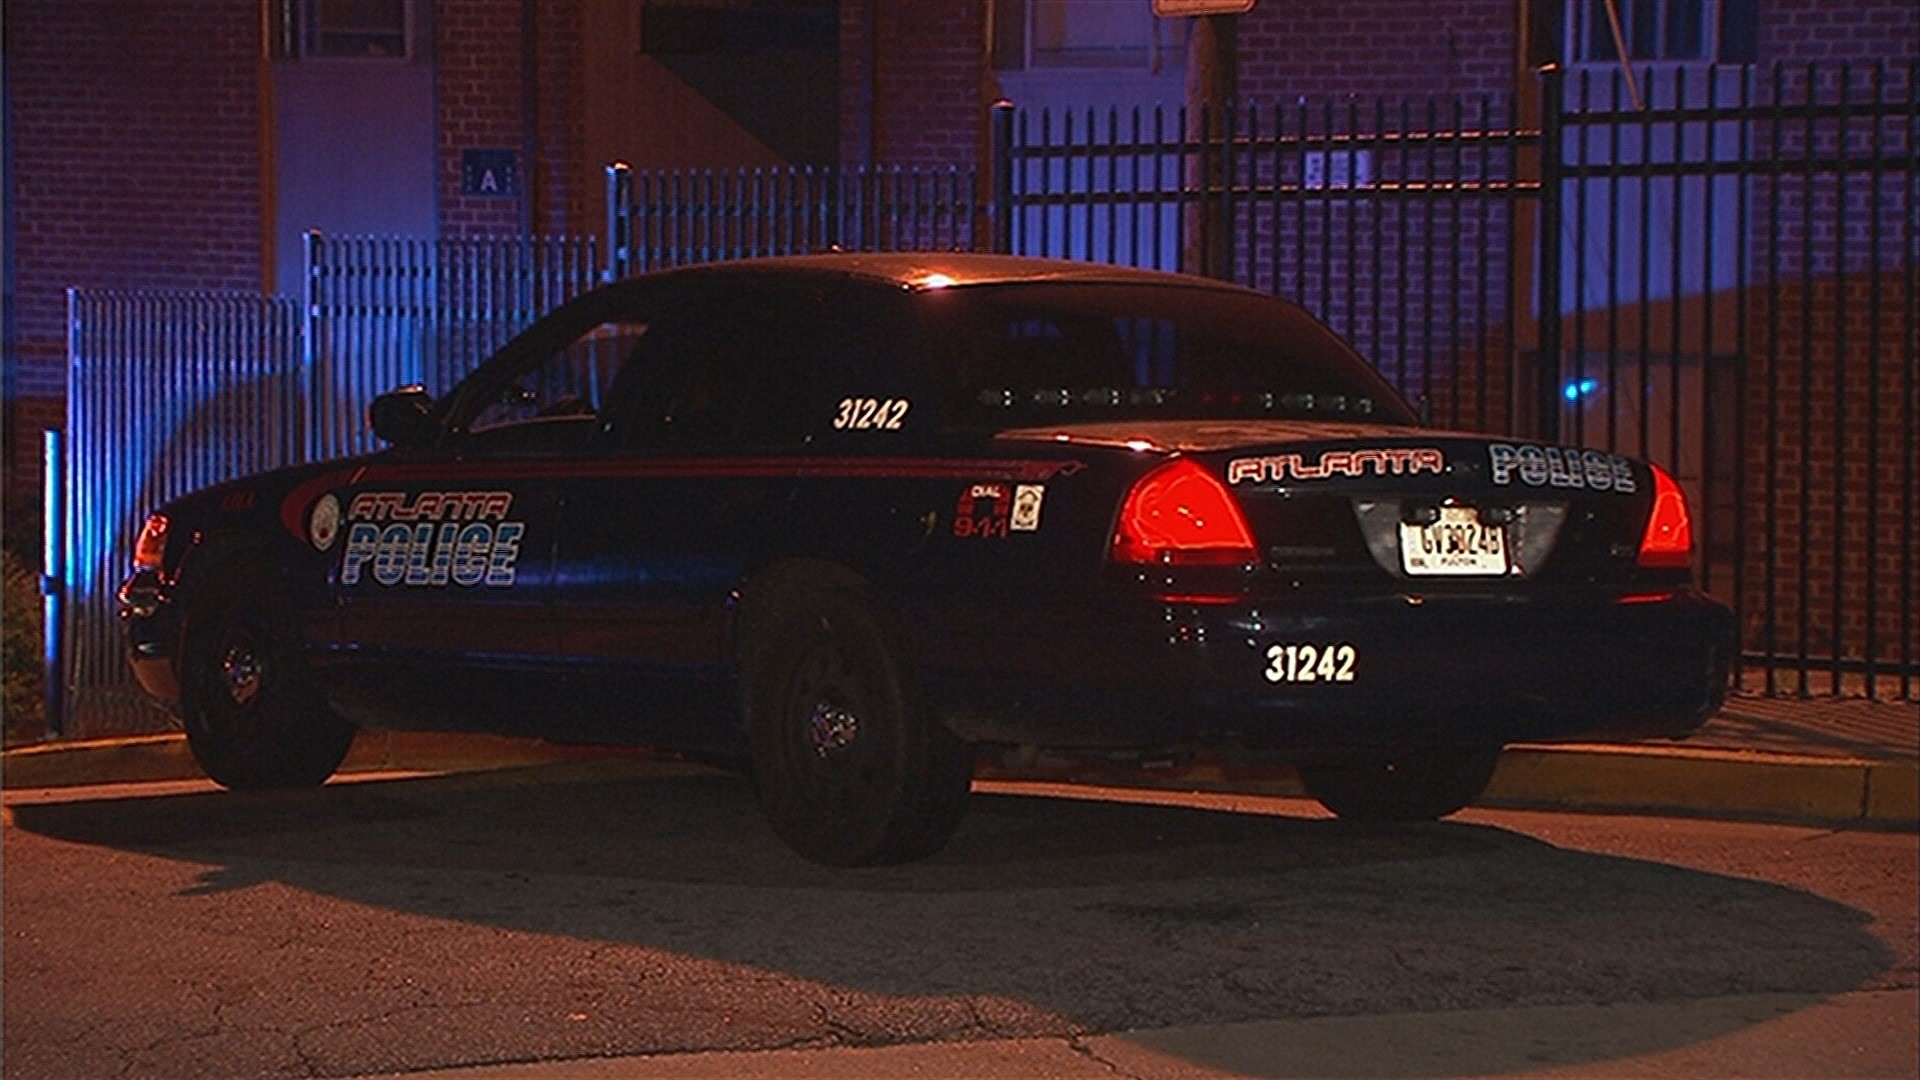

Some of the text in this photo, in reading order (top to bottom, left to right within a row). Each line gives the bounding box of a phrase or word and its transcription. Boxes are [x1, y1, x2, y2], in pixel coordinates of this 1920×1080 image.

[480, 168, 498, 192] A
[833, 397, 909, 430] 31242
[1228, 442, 1637, 494] ATLANTA POLICE
[348, 490, 514, 521] ATLANTA
[340, 520, 526, 586] POLICE
[1264, 644, 1357, 683] 31242
